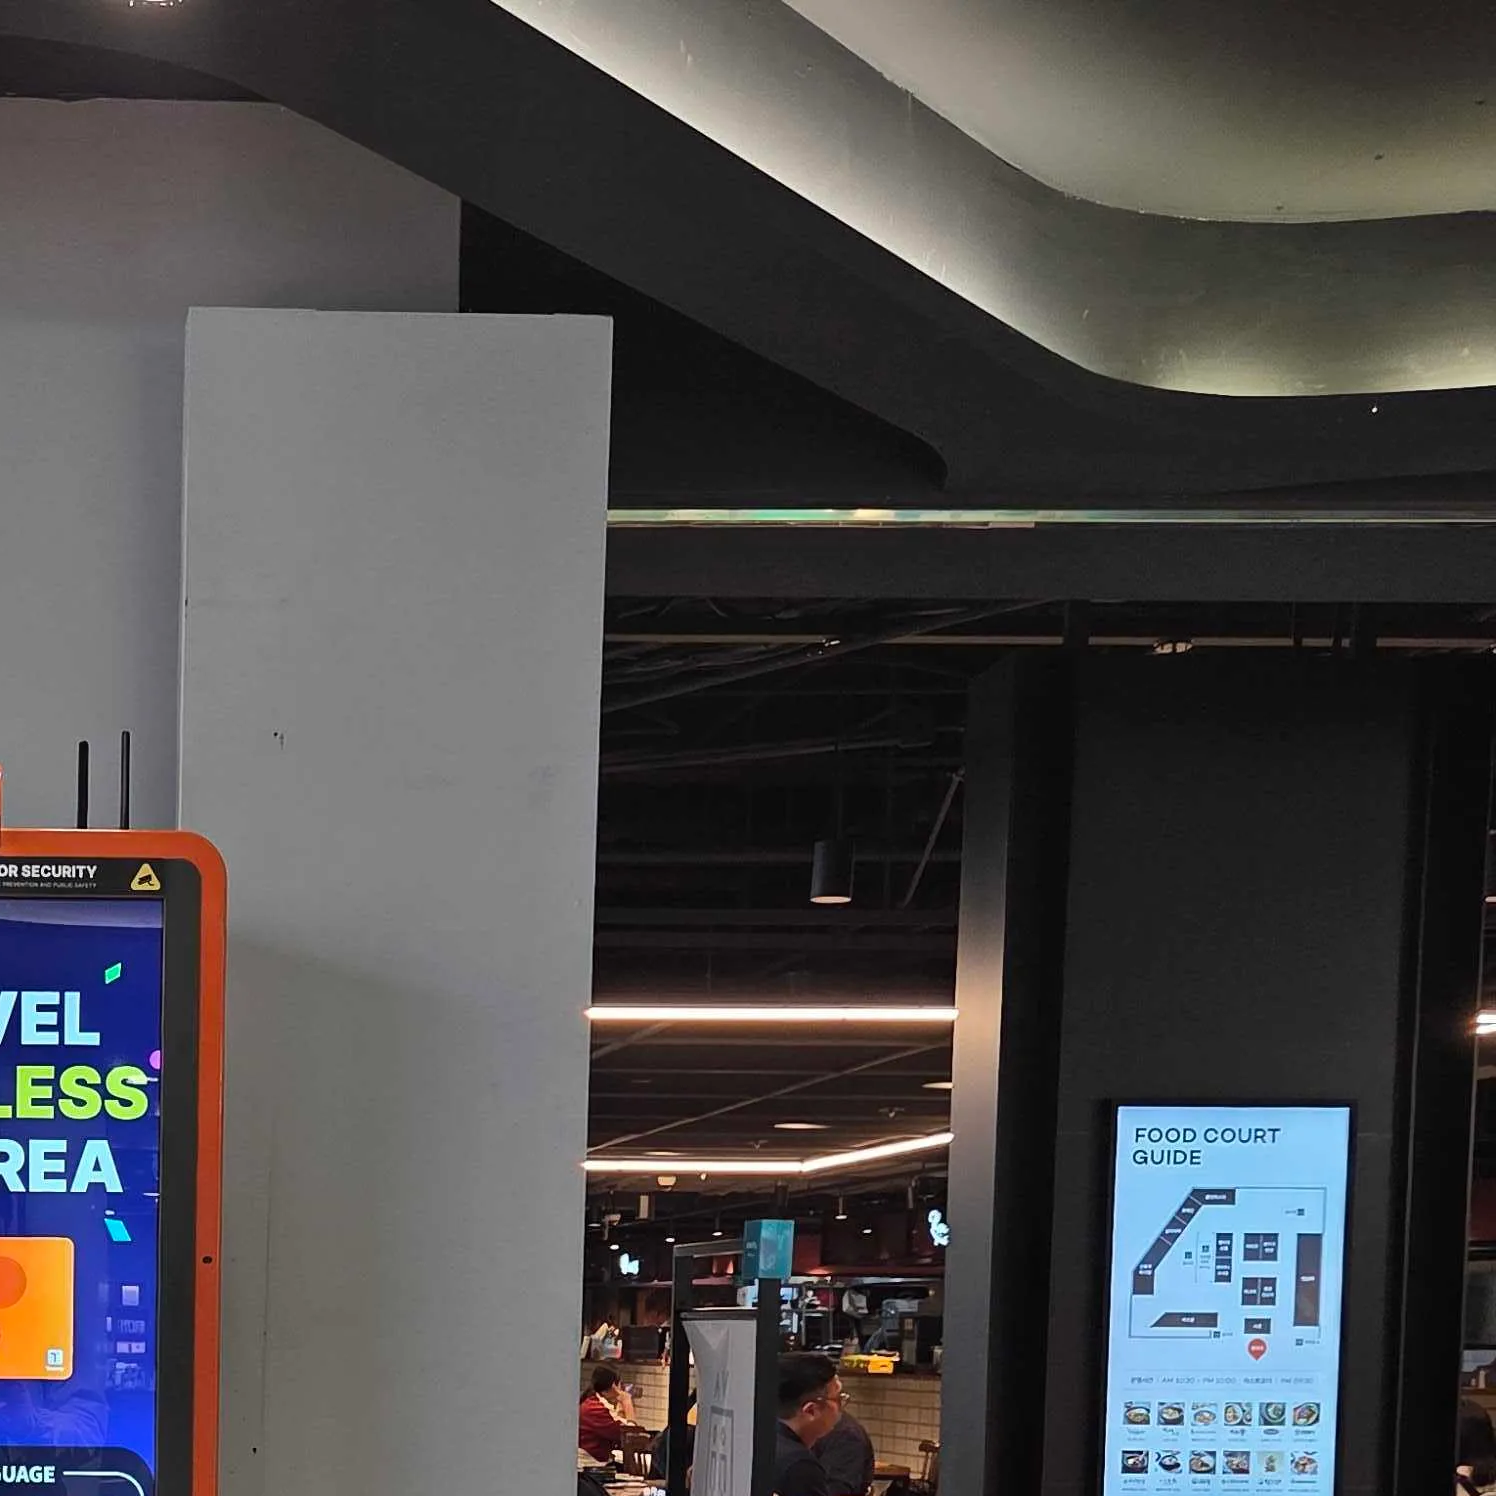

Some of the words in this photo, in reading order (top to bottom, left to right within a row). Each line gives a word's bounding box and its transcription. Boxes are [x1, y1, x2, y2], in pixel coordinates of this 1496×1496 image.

[21, 864, 98, 879] SECURITY
[1135, 1128, 1197, 1143] FOOD
[1204, 1128, 1281, 1144] COURT
[1133, 1150, 1202, 1165] GUIDE
